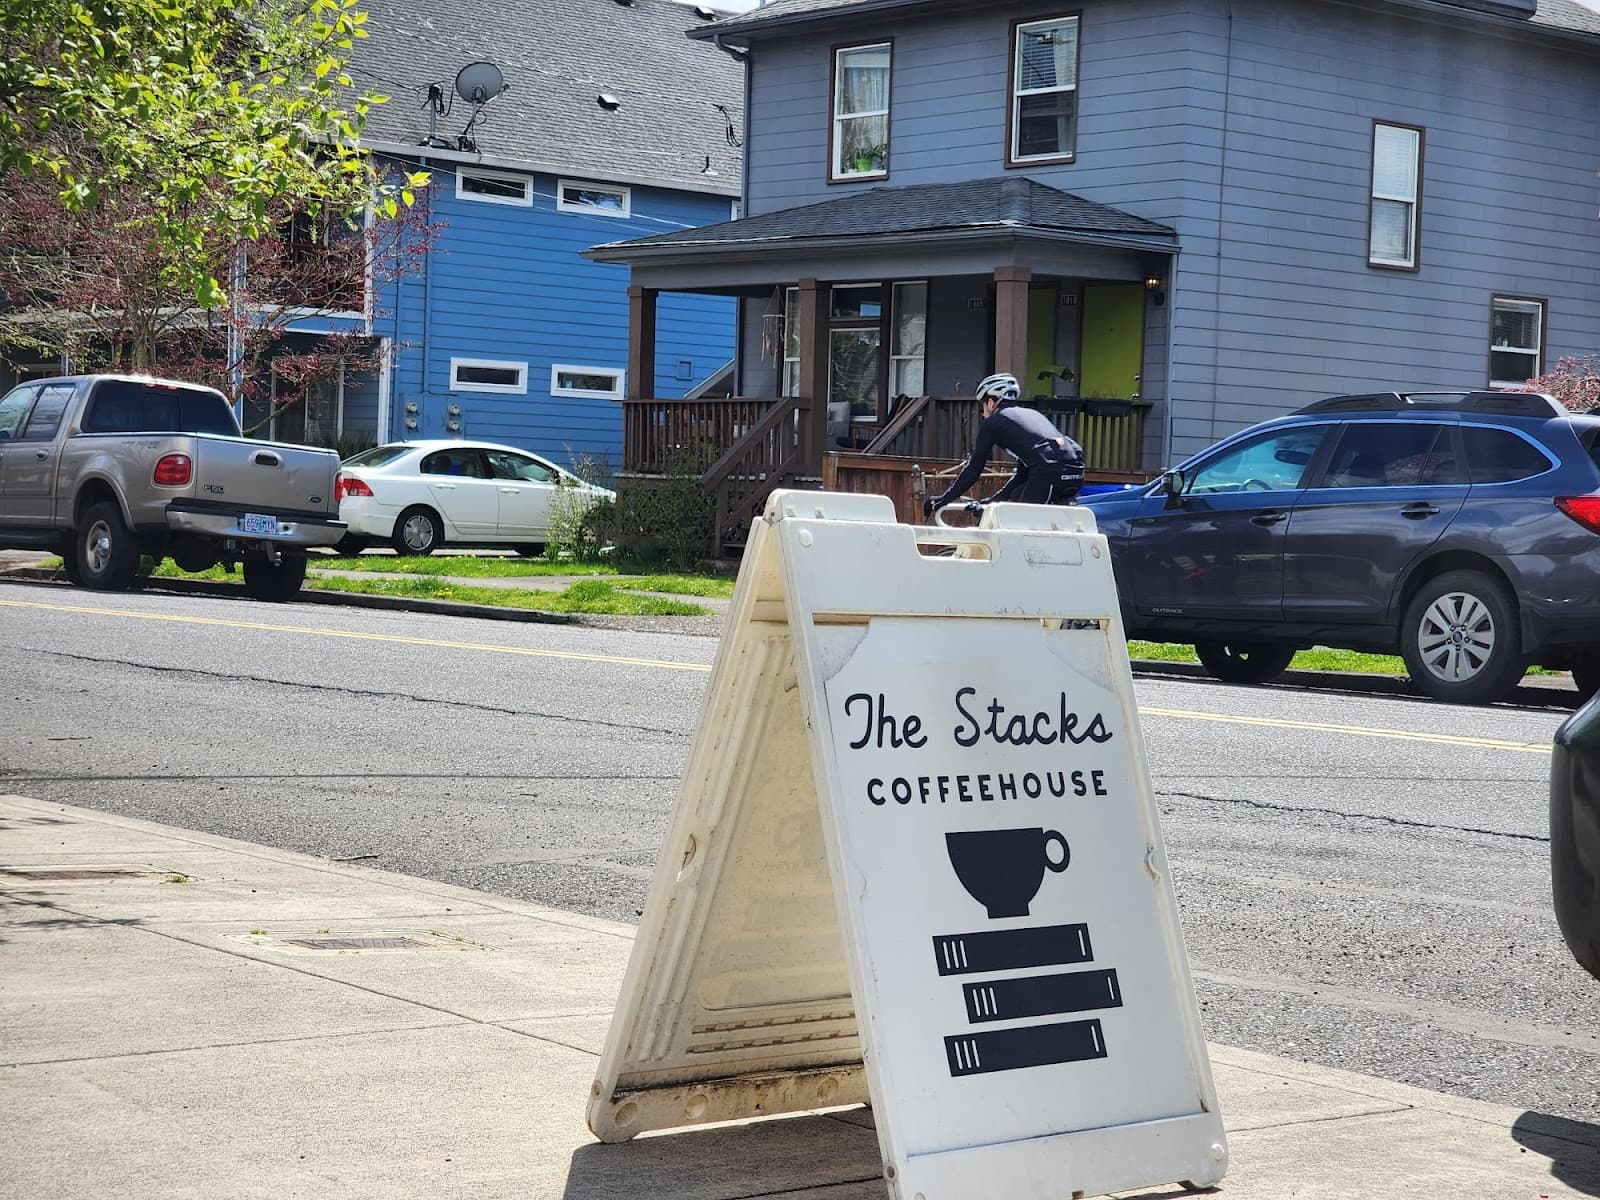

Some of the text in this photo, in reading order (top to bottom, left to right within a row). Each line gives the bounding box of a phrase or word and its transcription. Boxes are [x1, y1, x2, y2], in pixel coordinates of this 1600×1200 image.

[844, 686, 1113, 750] The Stacks
[867, 769, 1108, 806] COFFEEHOUSE
